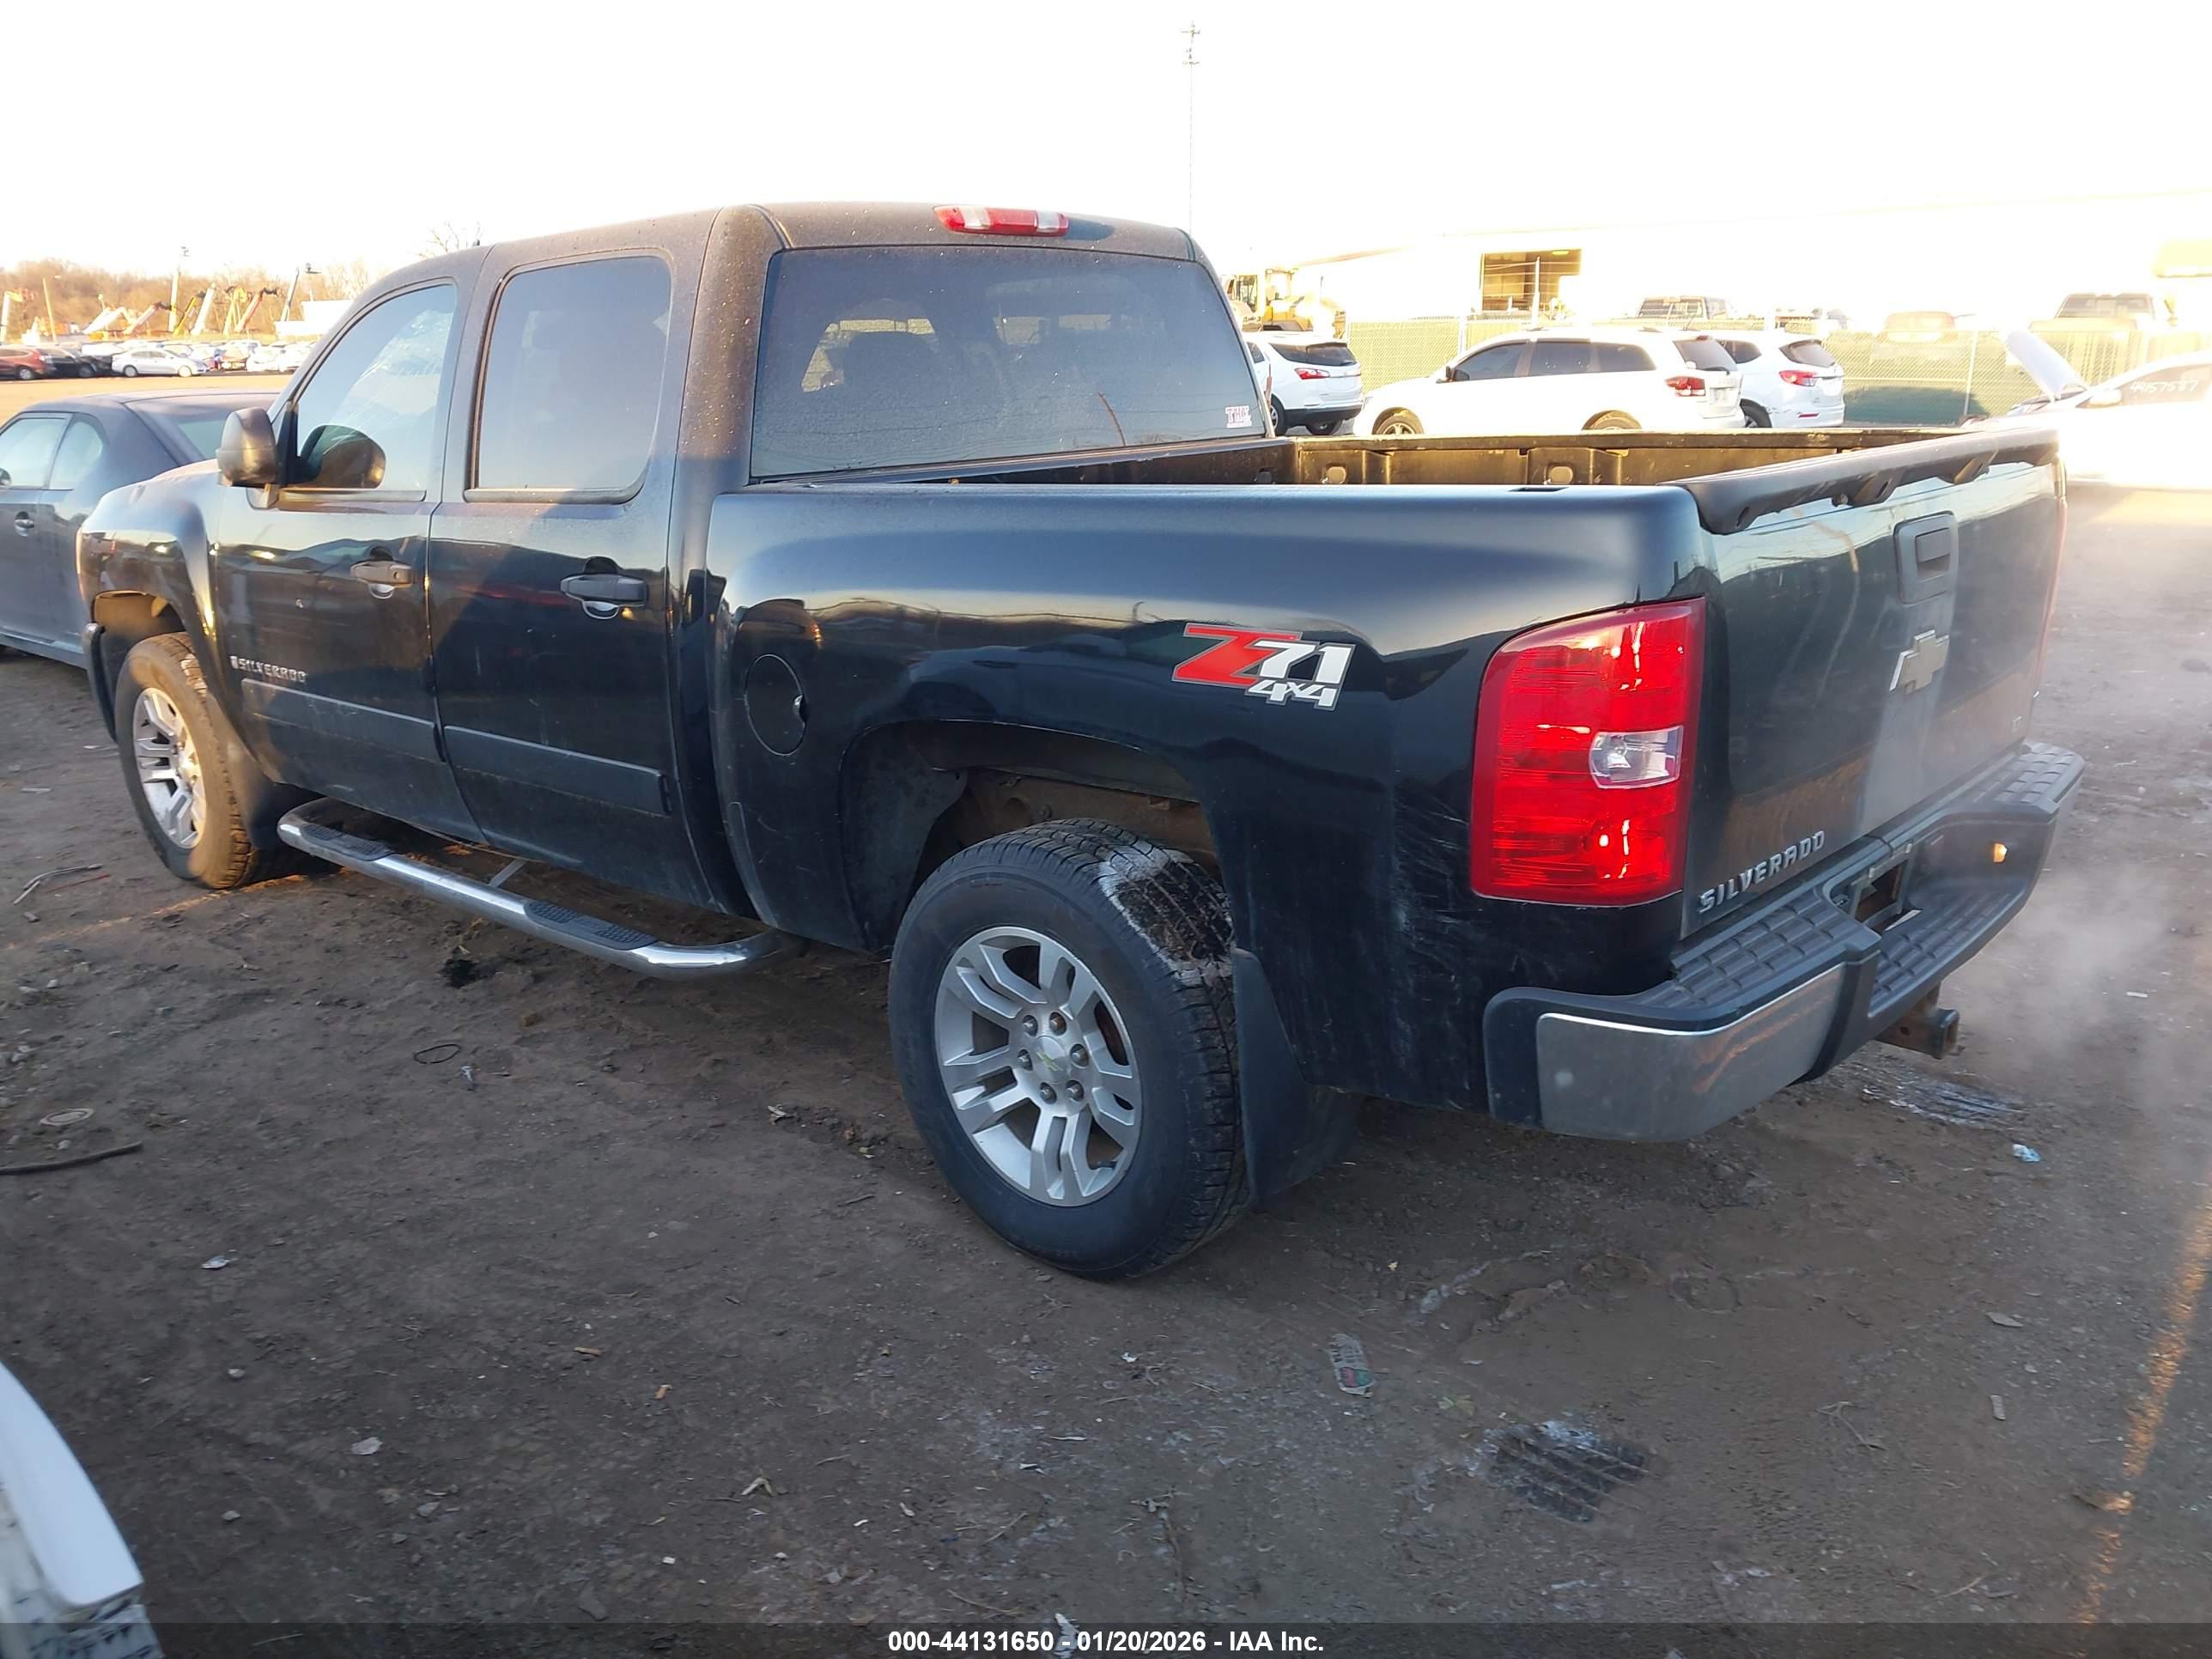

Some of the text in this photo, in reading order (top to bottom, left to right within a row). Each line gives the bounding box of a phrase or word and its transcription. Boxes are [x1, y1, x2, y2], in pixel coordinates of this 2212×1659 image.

[238, 658, 307, 683] SILVERADO
[1171, 623, 1356, 688] Z71
[1698, 830, 1825, 914] SILVERADO
